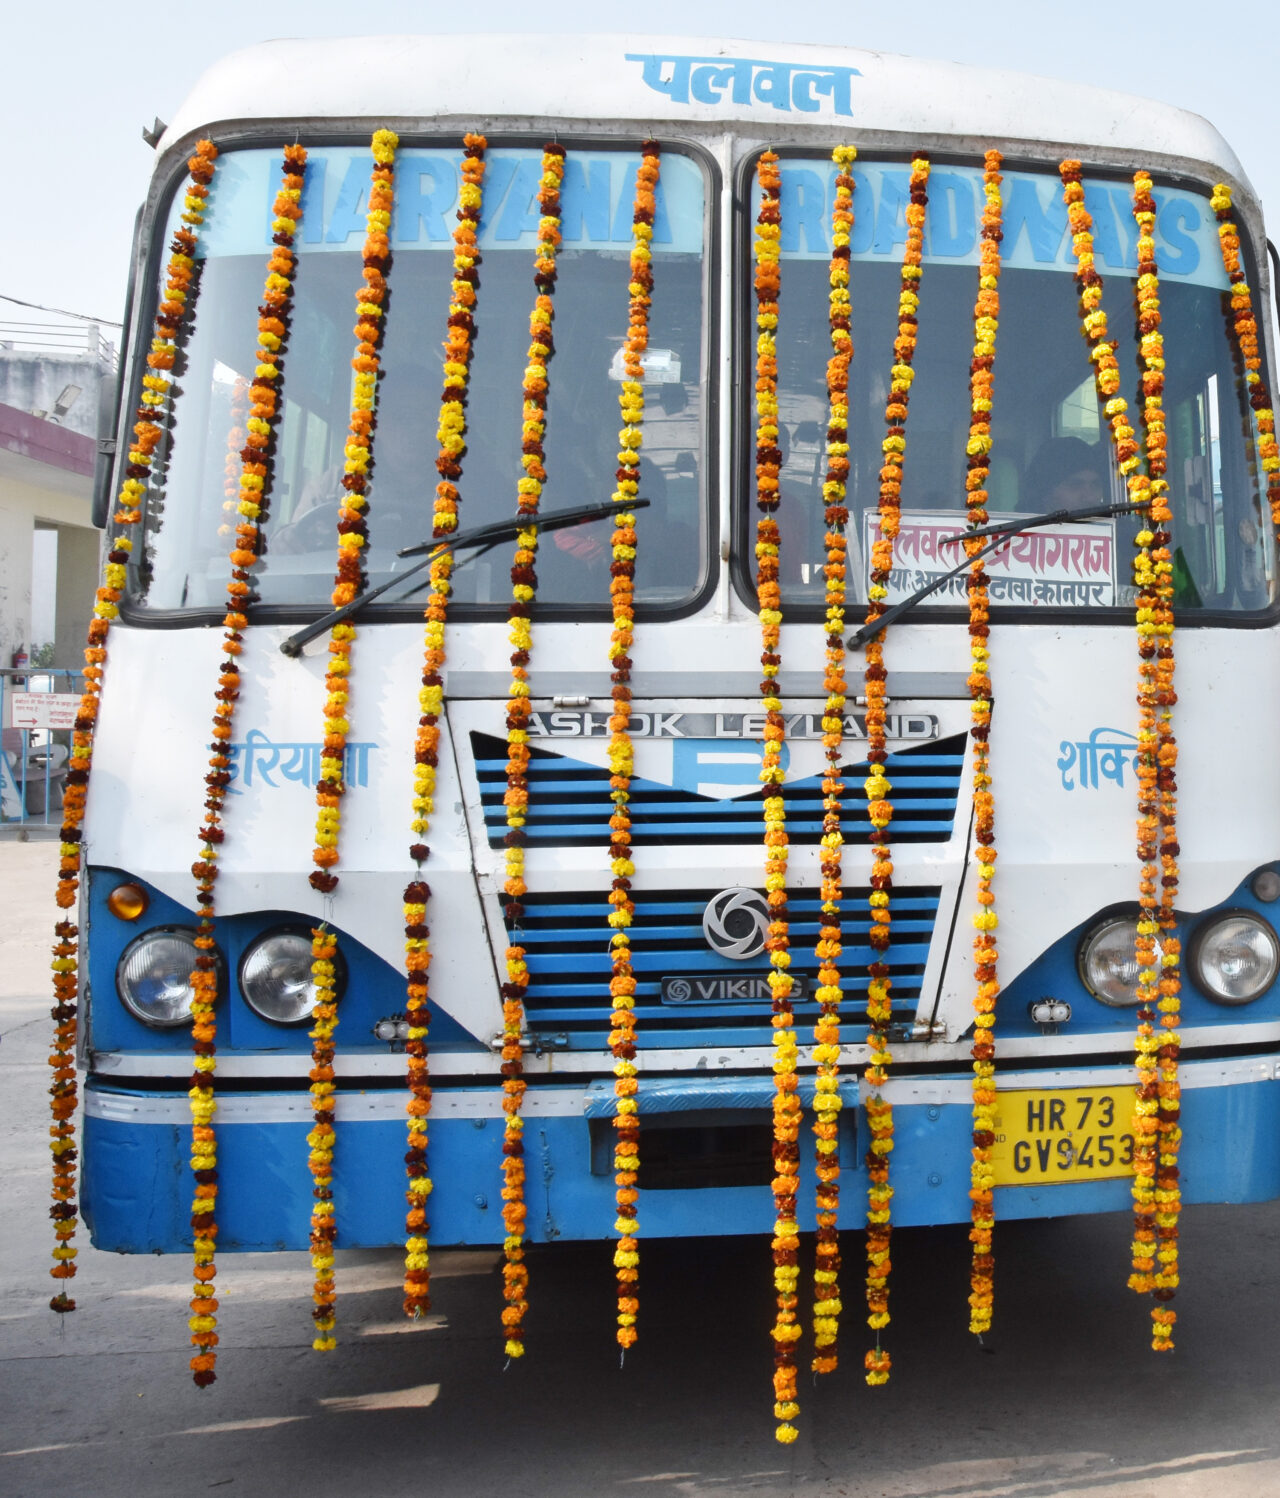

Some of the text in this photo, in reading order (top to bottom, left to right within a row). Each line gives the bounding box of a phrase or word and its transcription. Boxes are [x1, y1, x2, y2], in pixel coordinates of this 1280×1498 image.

[624, 53, 864, 117] पलवल
[1027, 1096, 1114, 1133] HR 73
[1014, 1133, 1135, 1173] GV9453
